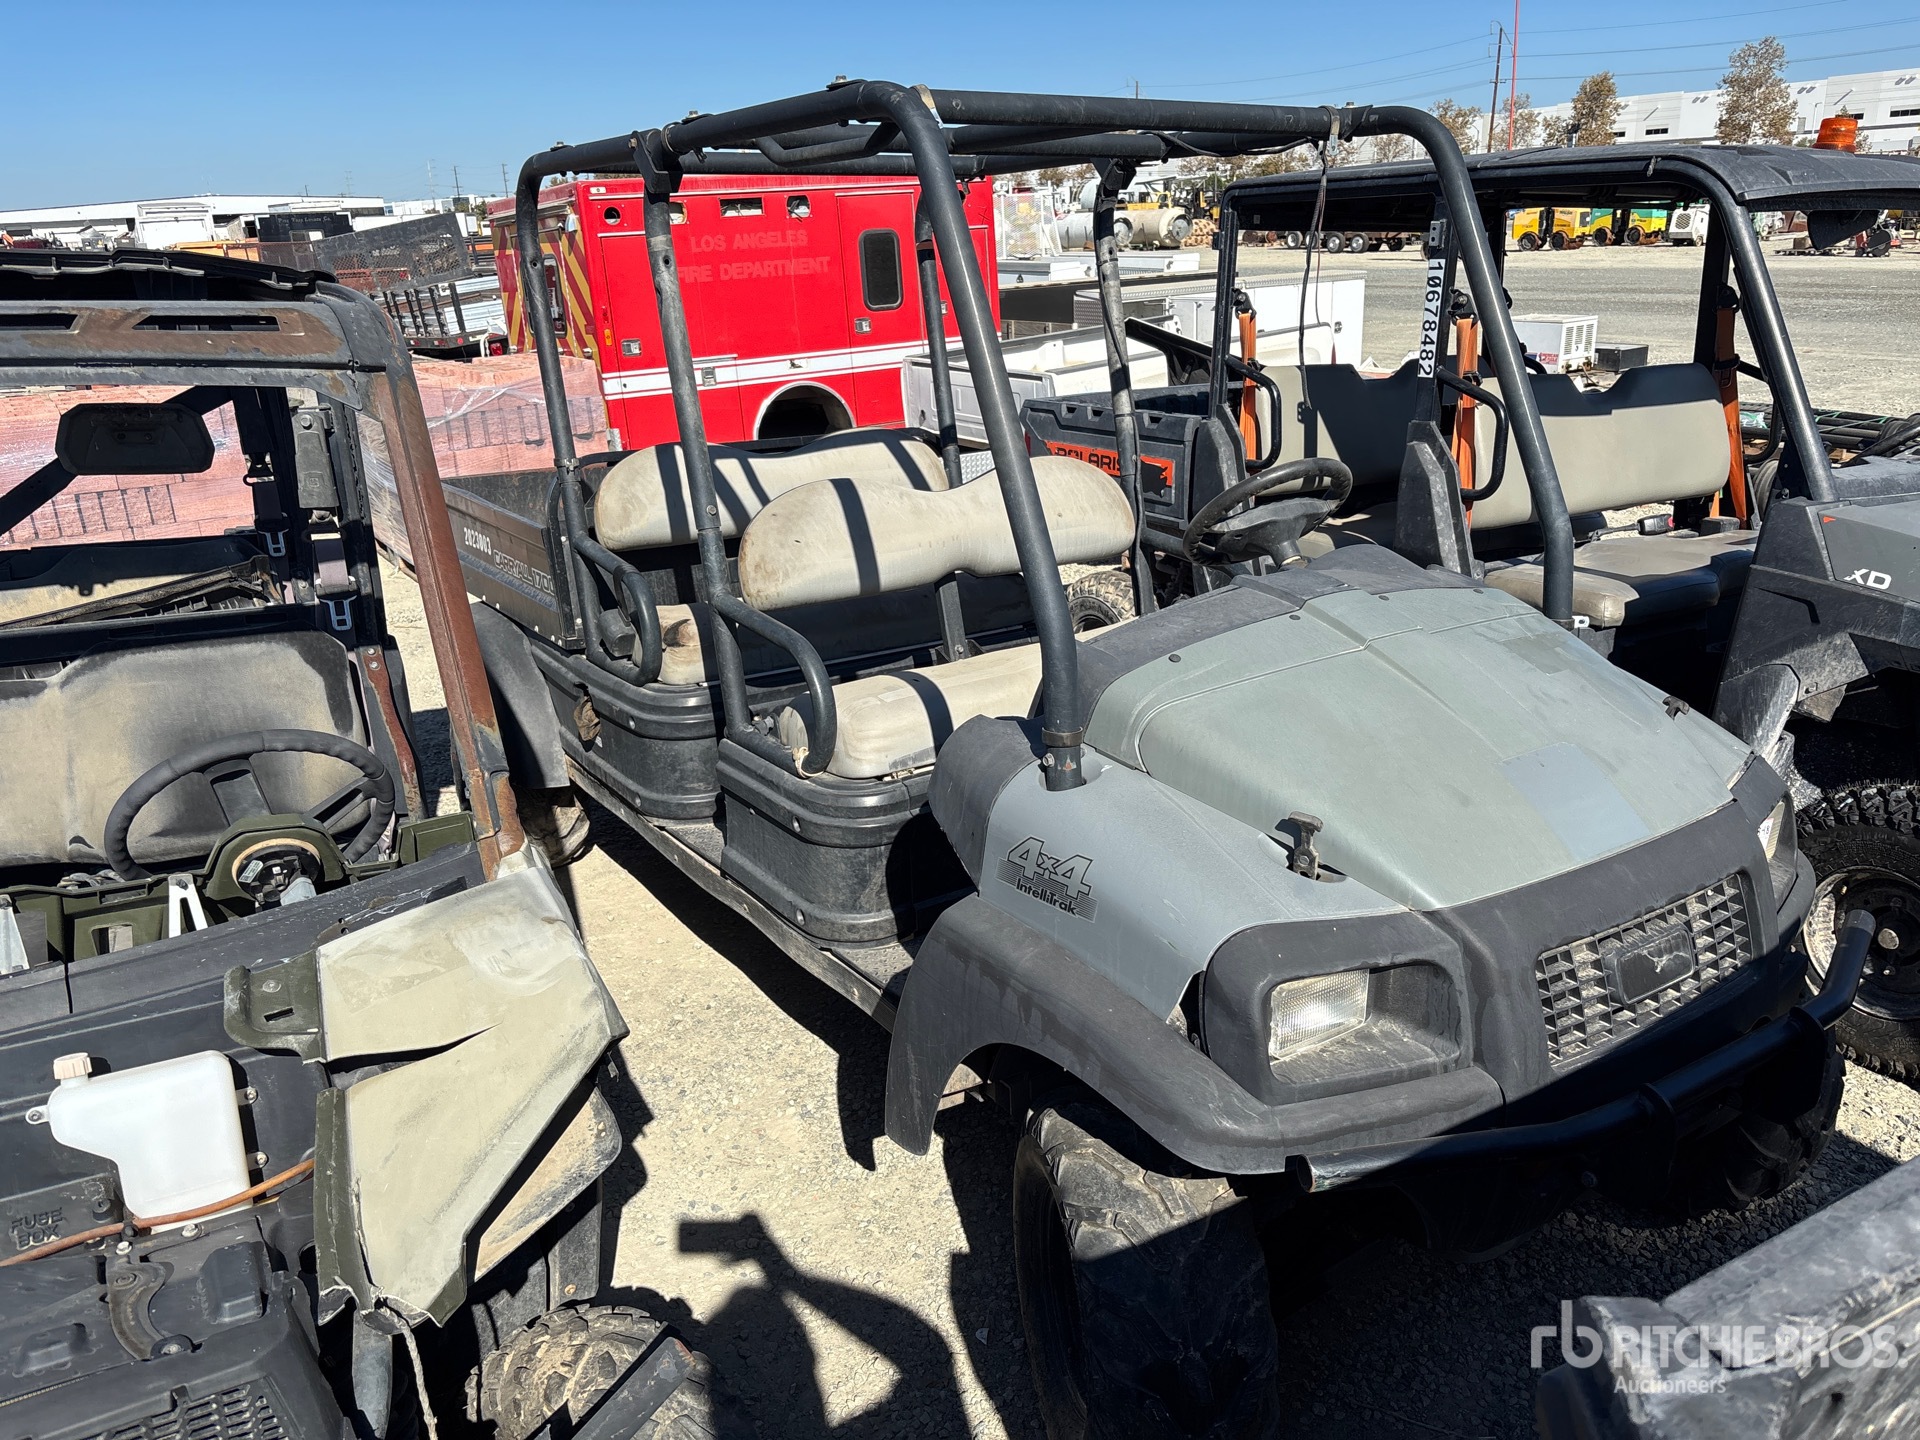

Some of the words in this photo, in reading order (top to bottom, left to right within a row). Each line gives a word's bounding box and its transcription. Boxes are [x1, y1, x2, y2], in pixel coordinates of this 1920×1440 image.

[691, 235, 727, 253] LOS
[733, 230, 809, 250] ANGELES
[720, 256, 831, 281] DEPARTMENT
[1418, 261, 1444, 377] 10678482
[463, 527, 492, 556] 2023003
[493, 549, 534, 586] CARRYALL
[1006, 836, 1094, 901] 4x4
[1015, 878, 1078, 917] IntelliTrak
[11, 1206, 63, 1234] FUSE
[18, 1224, 61, 1250] BOX
